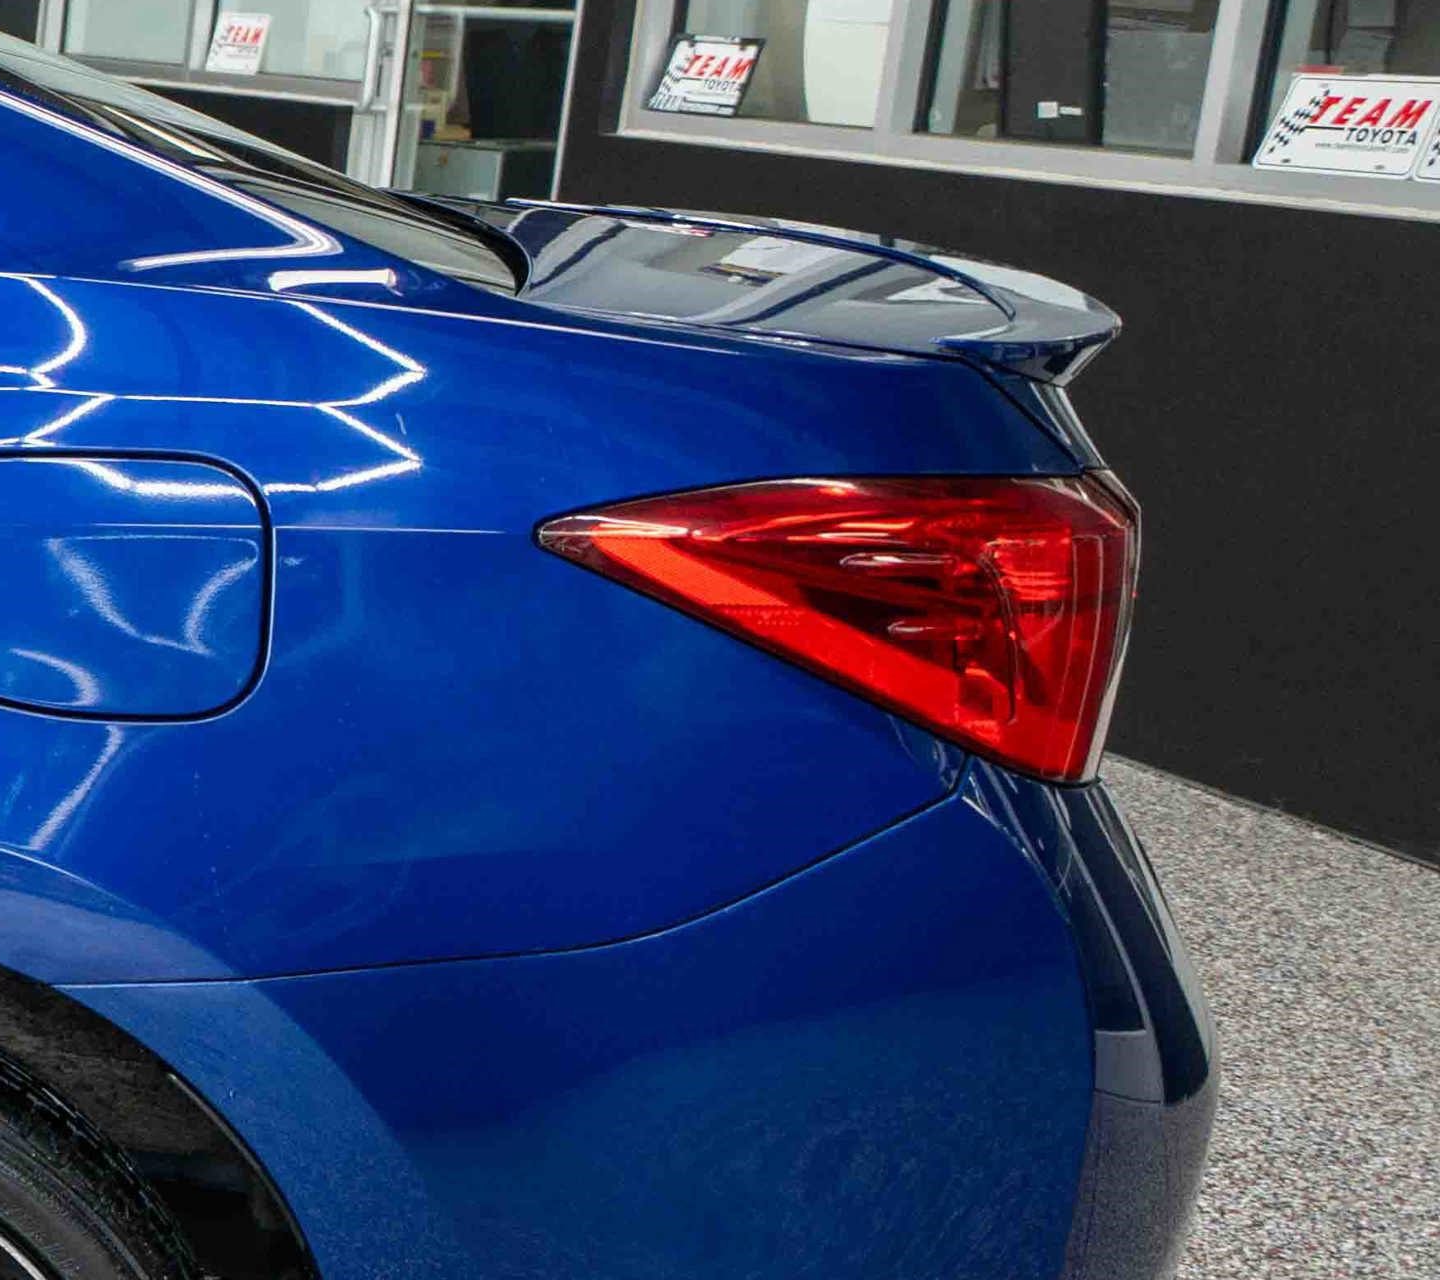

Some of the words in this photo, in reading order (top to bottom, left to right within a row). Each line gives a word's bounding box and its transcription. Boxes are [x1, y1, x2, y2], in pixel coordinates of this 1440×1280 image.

[683, 54, 754, 80] TEAM
[1308, 95, 1433, 129] TEAM
[1345, 127, 1418, 145] TOYOTA
